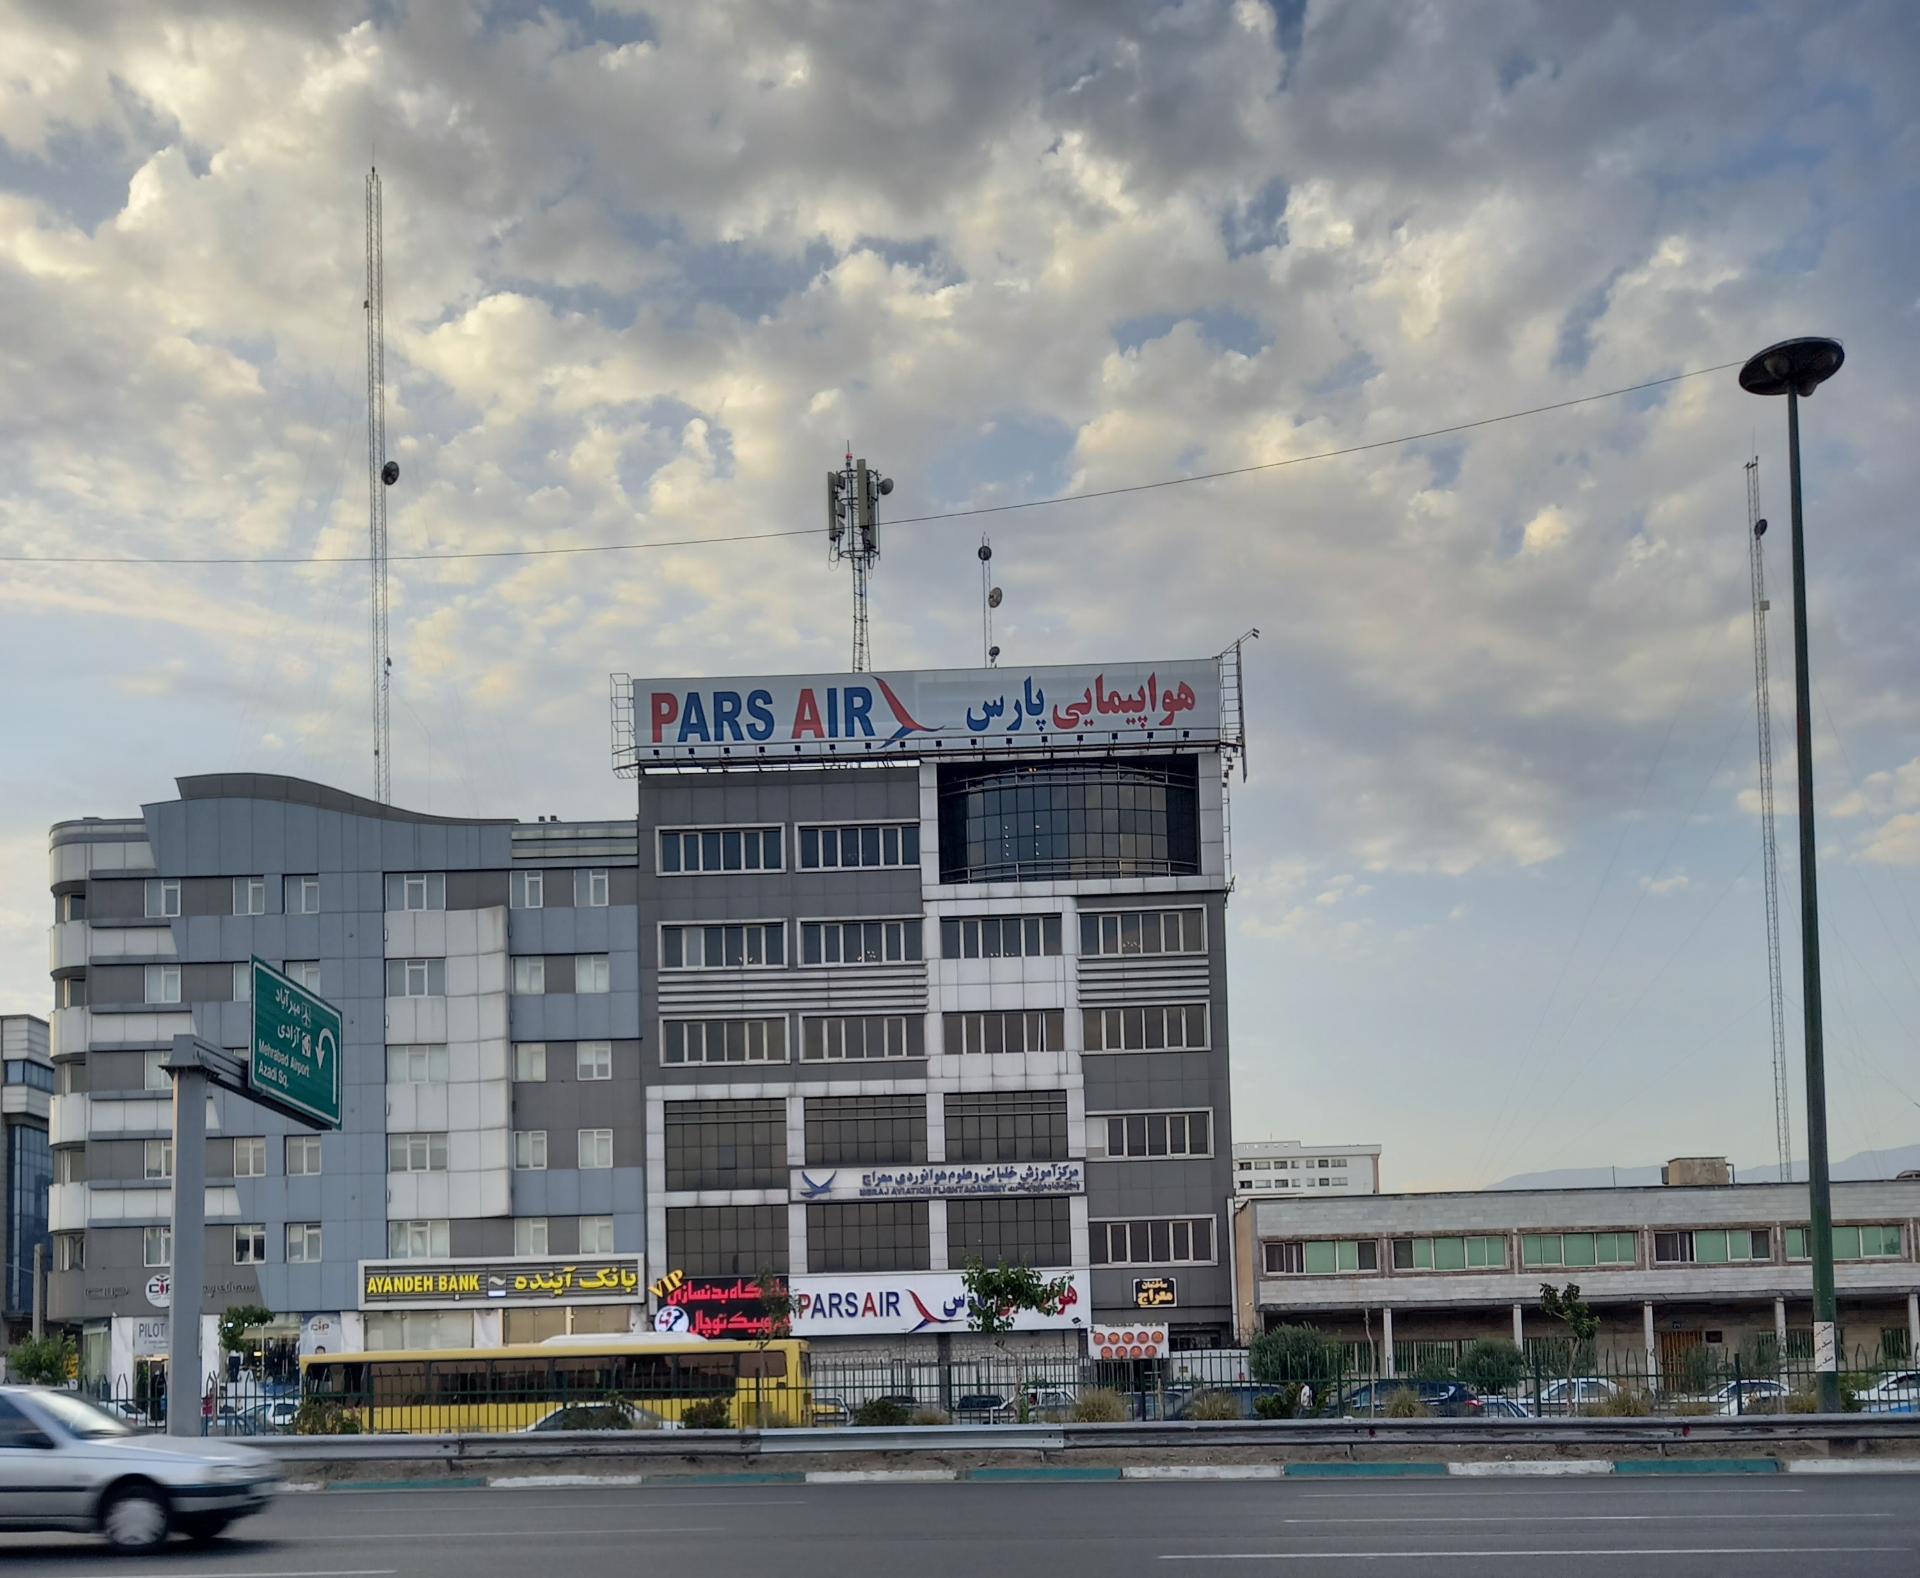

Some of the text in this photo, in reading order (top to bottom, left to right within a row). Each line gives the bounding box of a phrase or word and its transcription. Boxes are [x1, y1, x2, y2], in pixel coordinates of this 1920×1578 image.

[966, 671, 1196, 732] هواپیمایی پارس
[650, 686, 876, 744] PARS AIR
[277, 1024, 301, 1048] آزادی
[258, 1038, 310, 1078] Mehrabad Airport
[258, 1059, 289, 1089] Azadi Sq.
[862, 1170, 893, 1187] معراج
[895, 1167, 947, 1185] هوانوردی
[948, 1167, 972, 1184] علوم
[980, 1165, 1018, 1183] خلبانی
[1020, 1164, 1058, 1182] آموزش
[1055, 1164, 1079, 1181] مرکز
[891, 1186, 931, 1195] AVIATION
[933, 1185, 963, 1194] FLIGHT
[367, 1274, 480, 1294] AYANDEH BANK
[514, 1265, 637, 1295] بانک آینده
[647, 1269, 685, 1298] VIP
[799, 1291, 901, 1319] PARS AIR
[1137, 1288, 1173, 1305] معراج
[138, 1322, 166, 1338] PILOT
